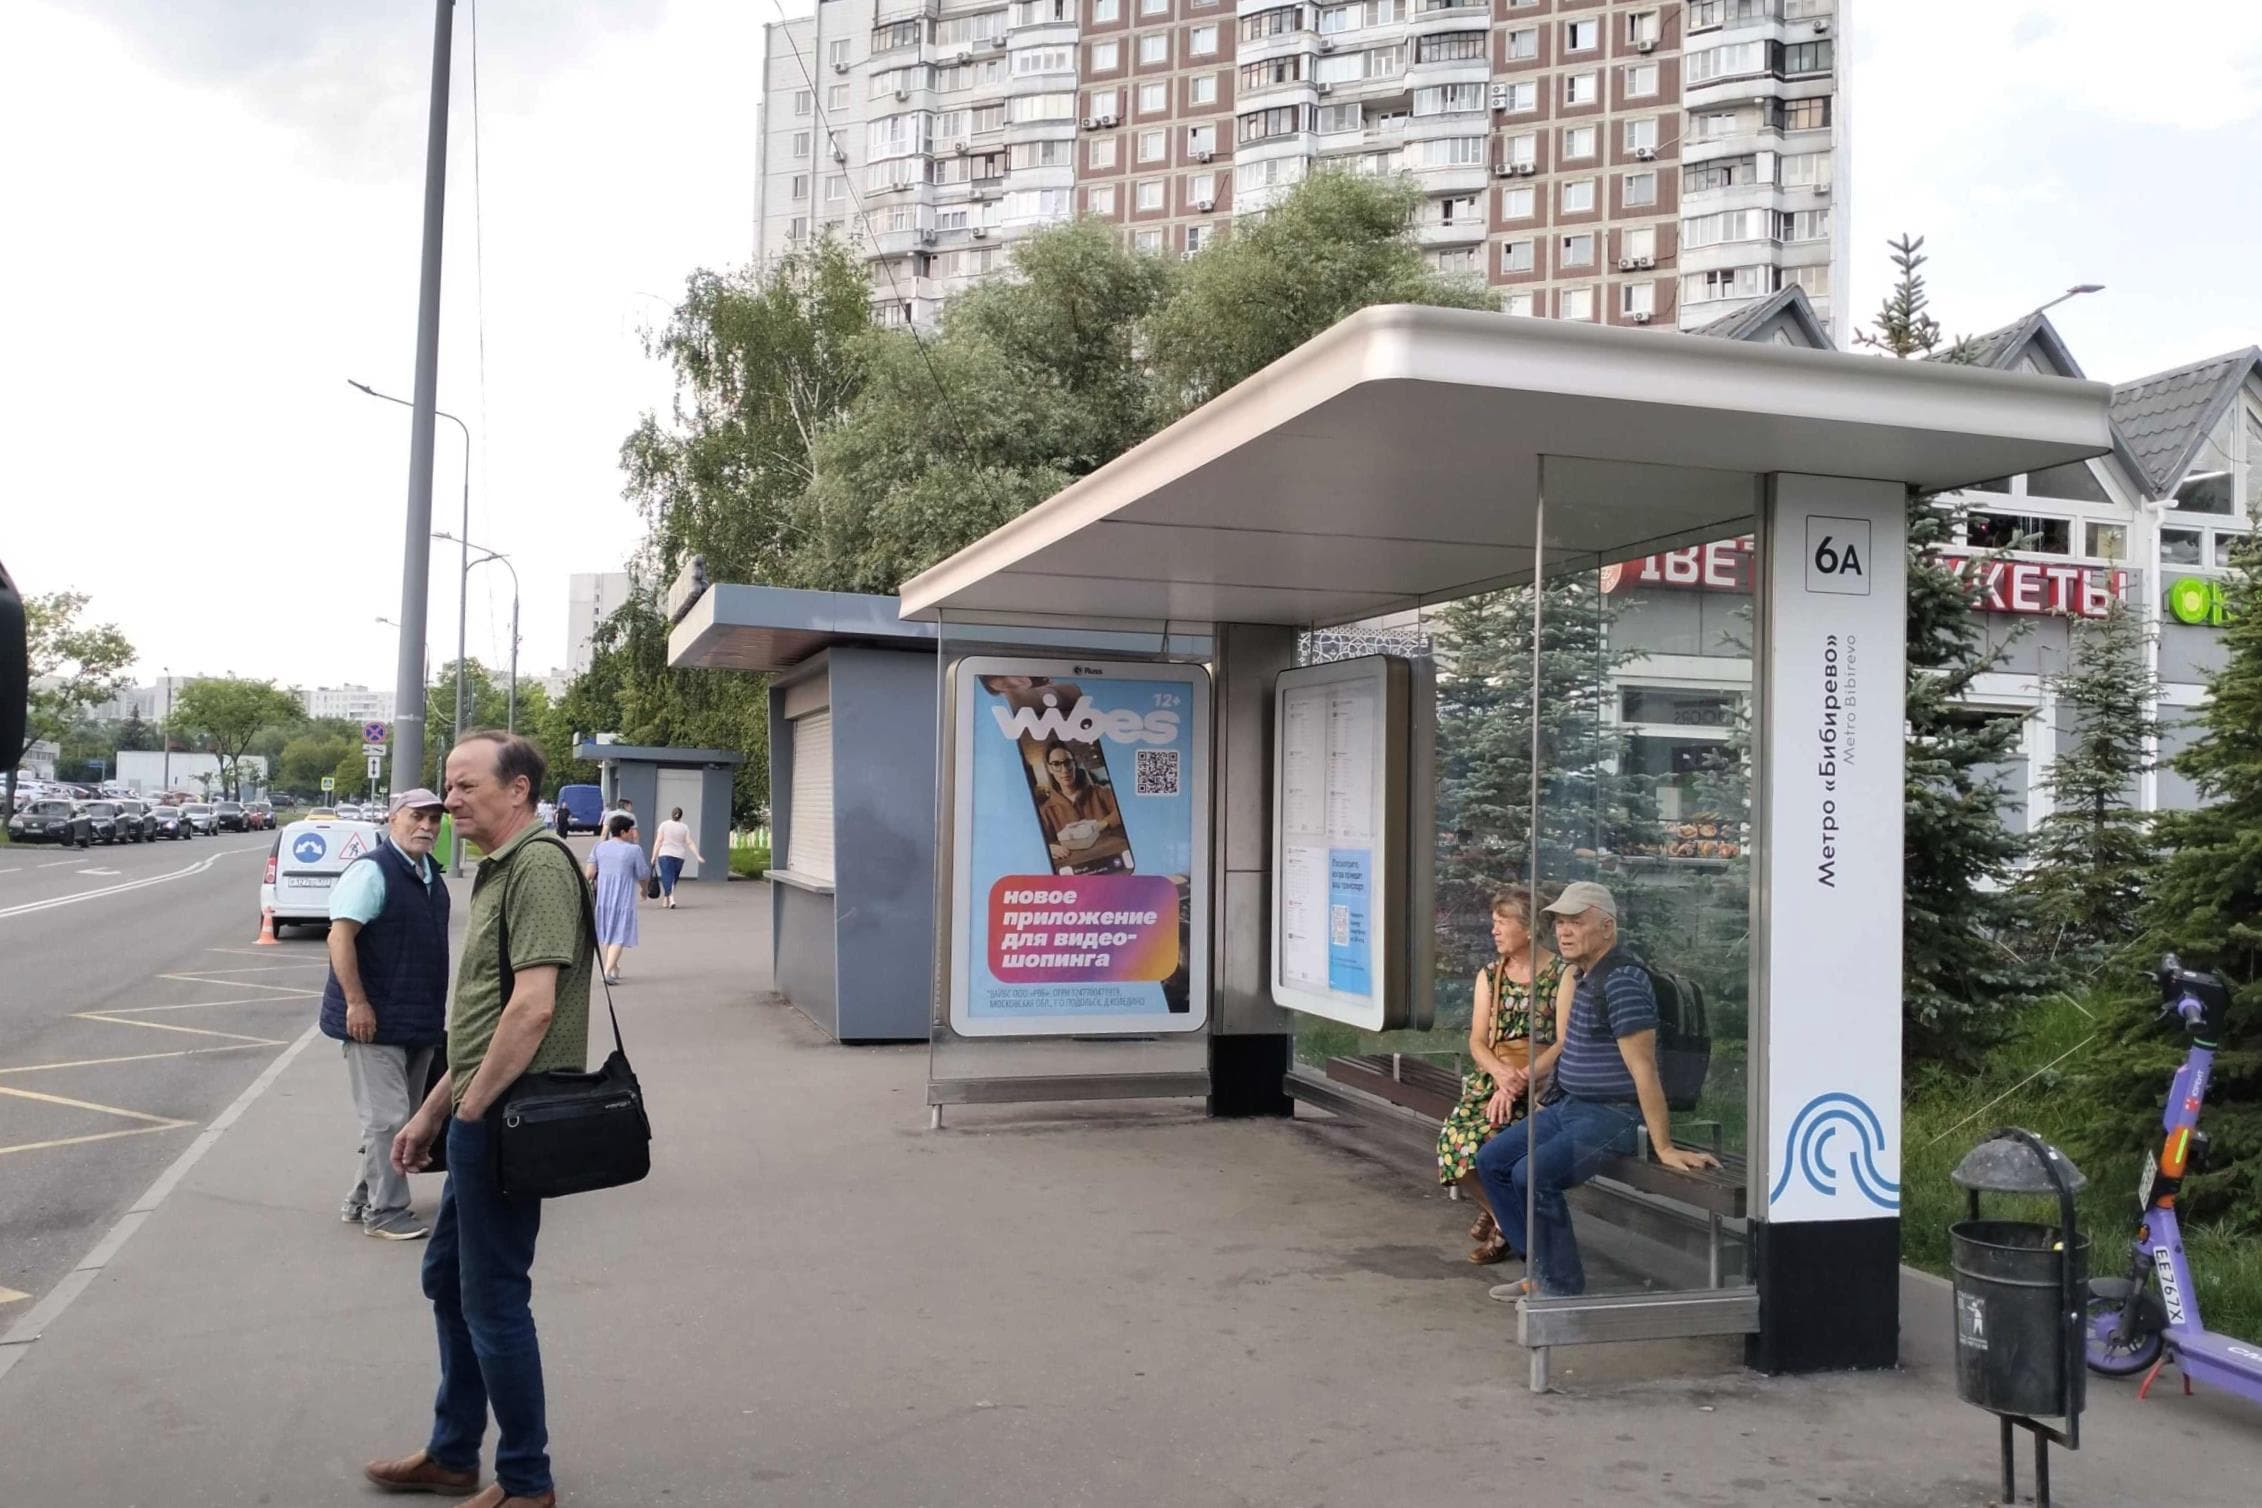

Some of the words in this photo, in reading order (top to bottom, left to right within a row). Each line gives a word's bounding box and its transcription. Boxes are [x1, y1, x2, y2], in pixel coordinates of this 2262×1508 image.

[1844, 634, 1857, 707] Bibirevo
[1152, 693, 1181, 708] 12+
[1818, 634, 1841, 792] «Бибирево»
[1843, 712, 1856, 766] Metro
[1818, 800, 1839, 888] Метро
[1003, 890, 1077, 905] новое
[1002, 910, 1158, 931] приложение
[1001, 931, 1048, 950] для
[1053, 931, 1137, 949] видео-
[1001, 952, 1111, 968] шопинга
